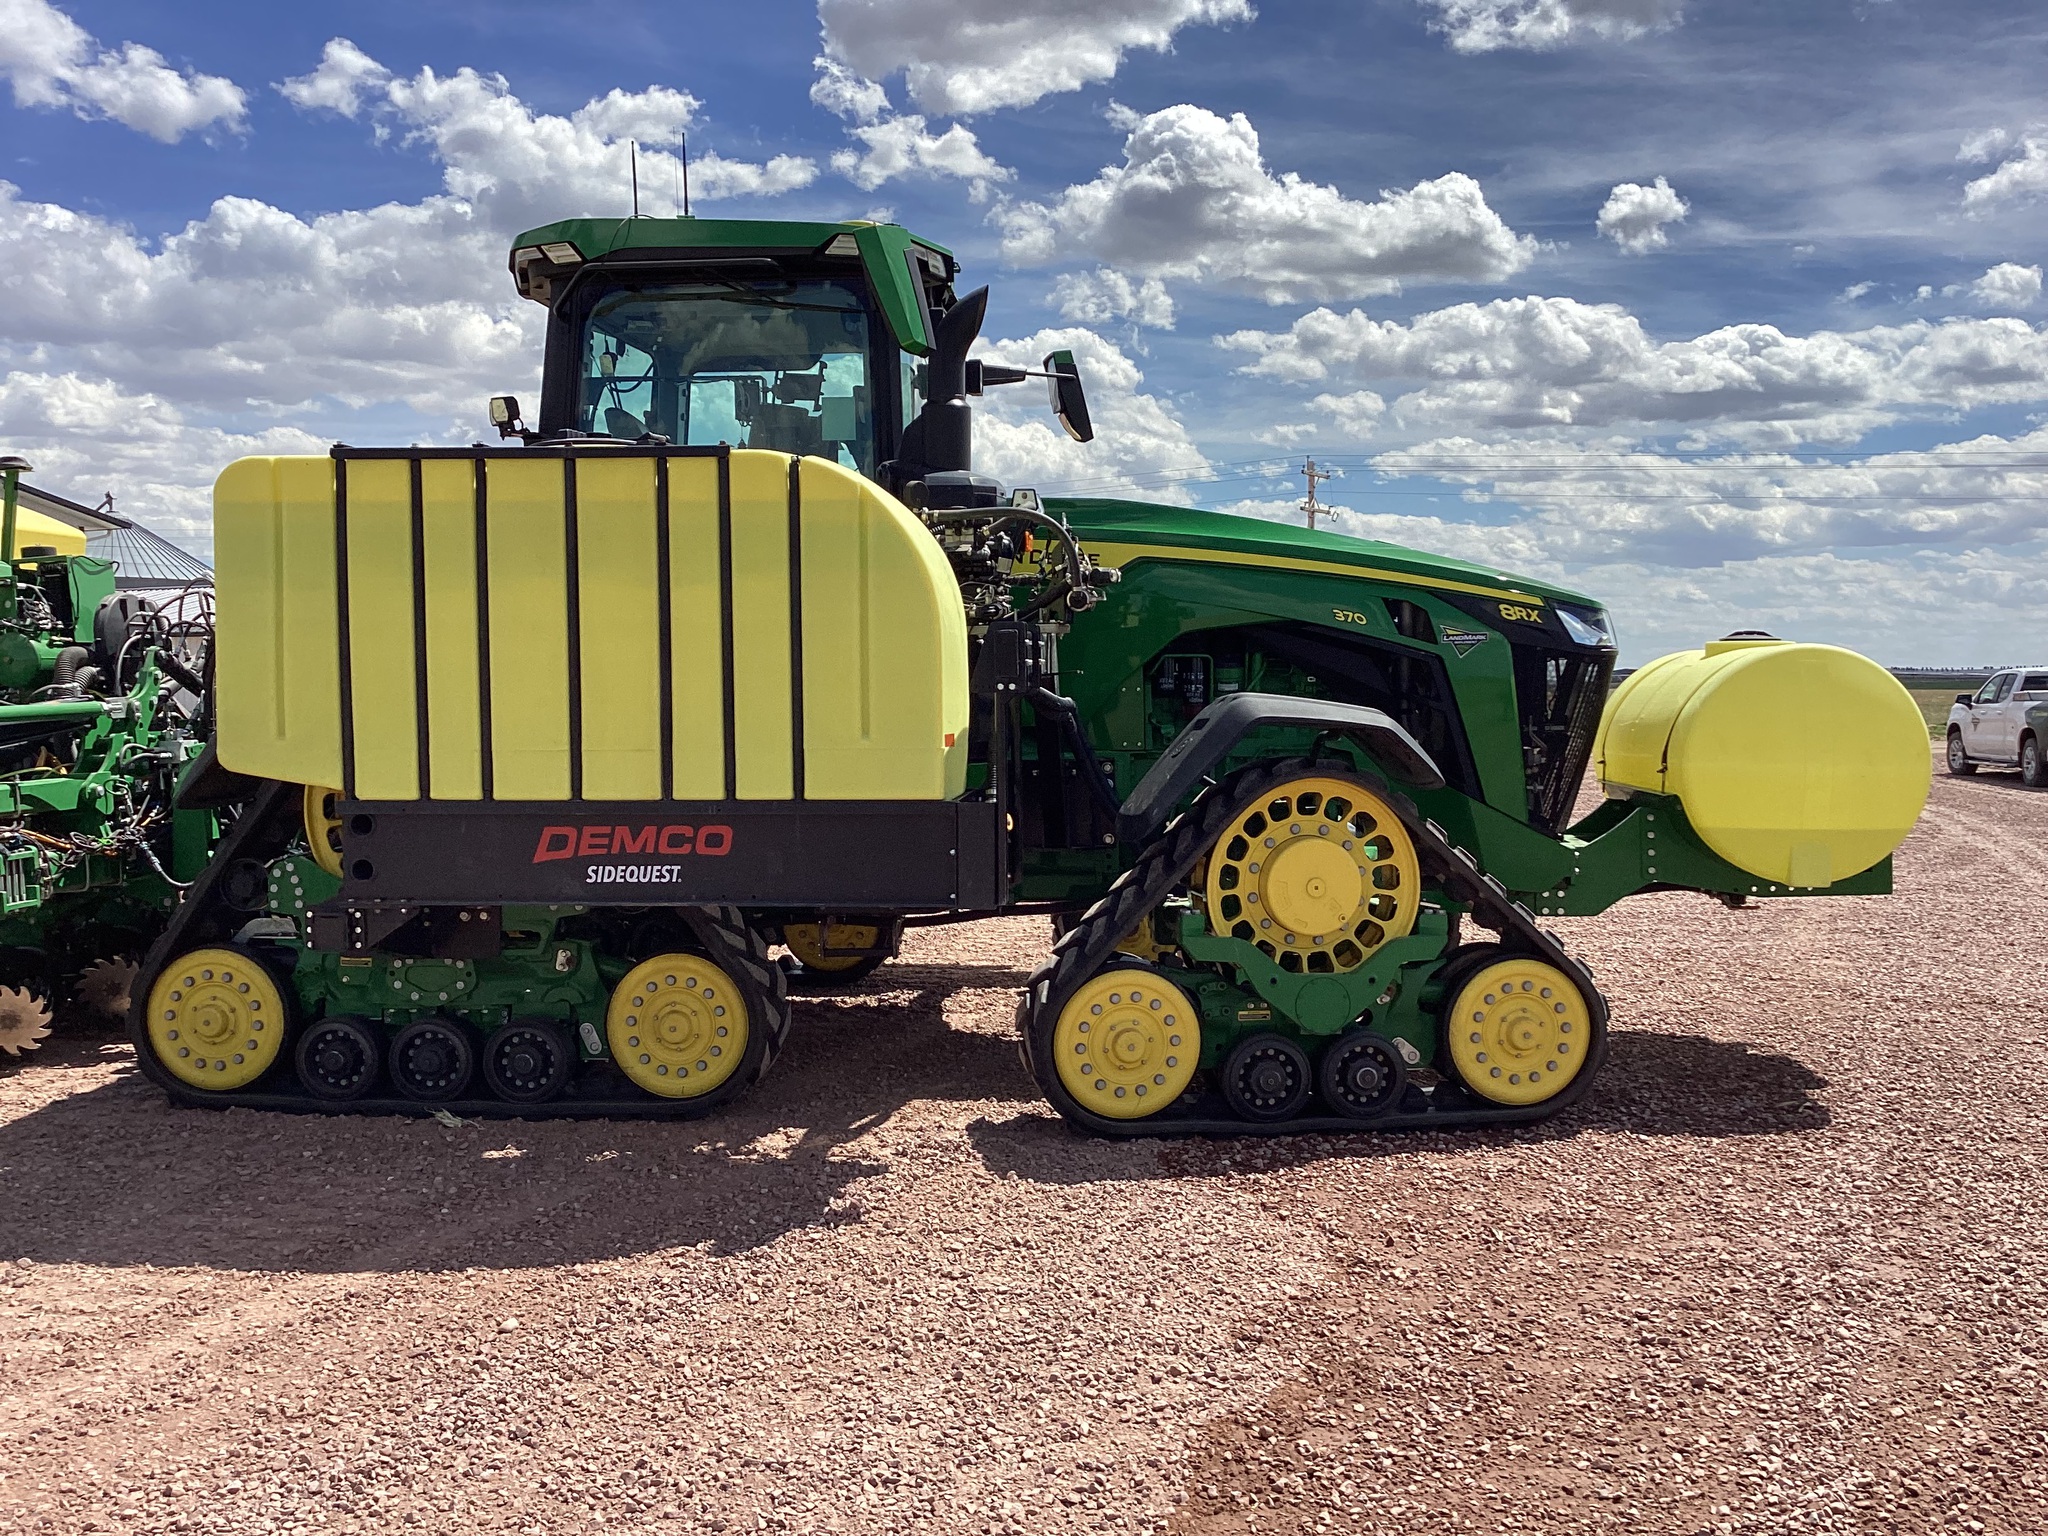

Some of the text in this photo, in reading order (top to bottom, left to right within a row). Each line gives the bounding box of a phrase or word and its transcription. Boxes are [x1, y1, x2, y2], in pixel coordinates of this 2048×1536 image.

[1332, 609, 1367, 625] 370
[1498, 603, 1543, 624] 8RX
[532, 825, 733, 864] DEMCO
[585, 865, 682, 883] SIDEQUEST
